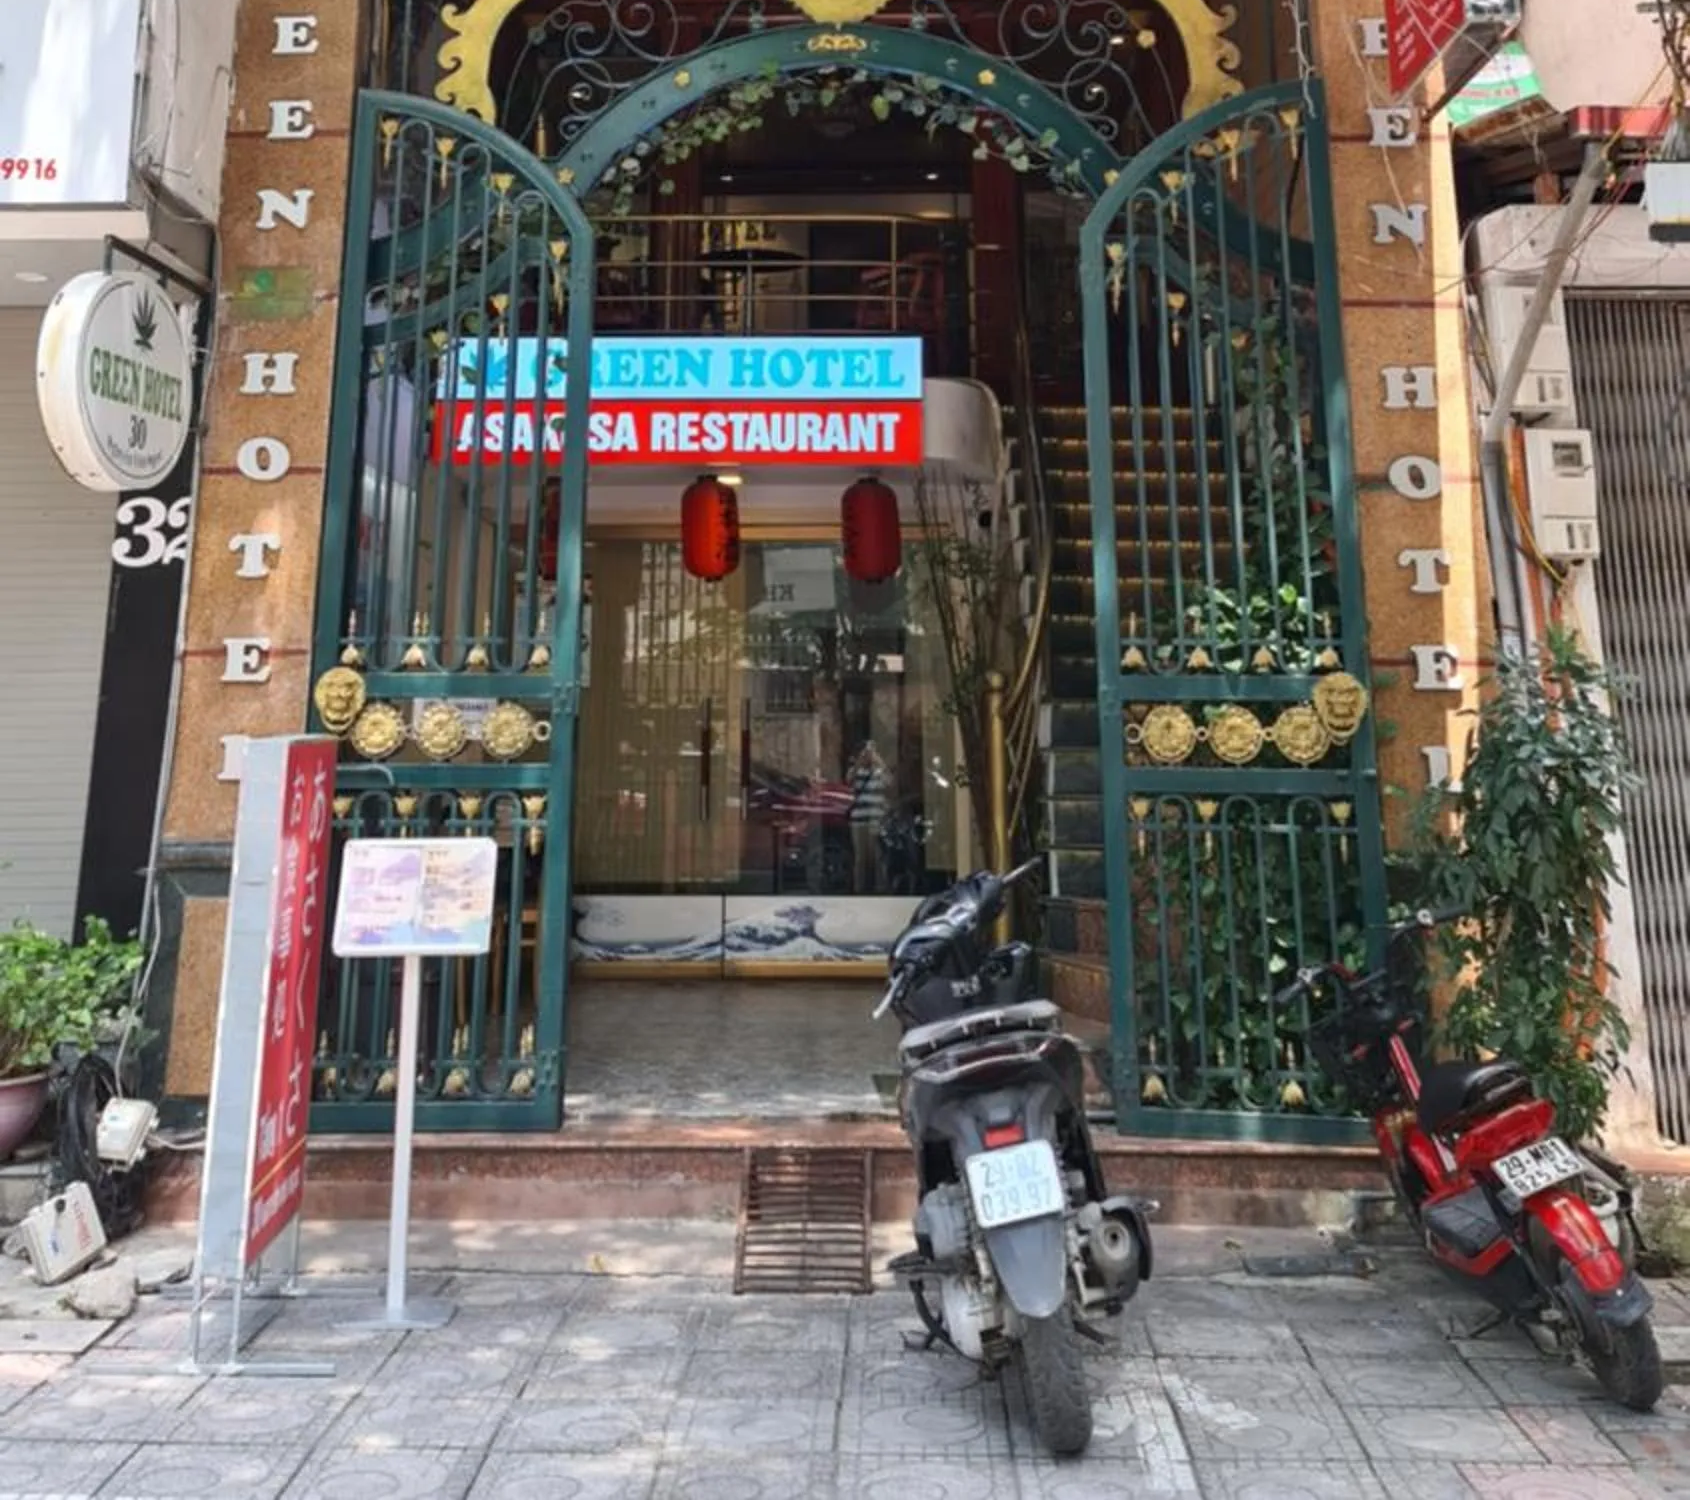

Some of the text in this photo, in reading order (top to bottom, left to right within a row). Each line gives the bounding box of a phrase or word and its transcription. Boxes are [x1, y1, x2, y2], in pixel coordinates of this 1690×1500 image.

[90, 346, 182, 422] GREEN HOTEL
[730, 348, 905, 390] HOTEL
[128, 414, 147, 449] 30
[456, 411, 901, 453] ASAKSA RESTAURANT
